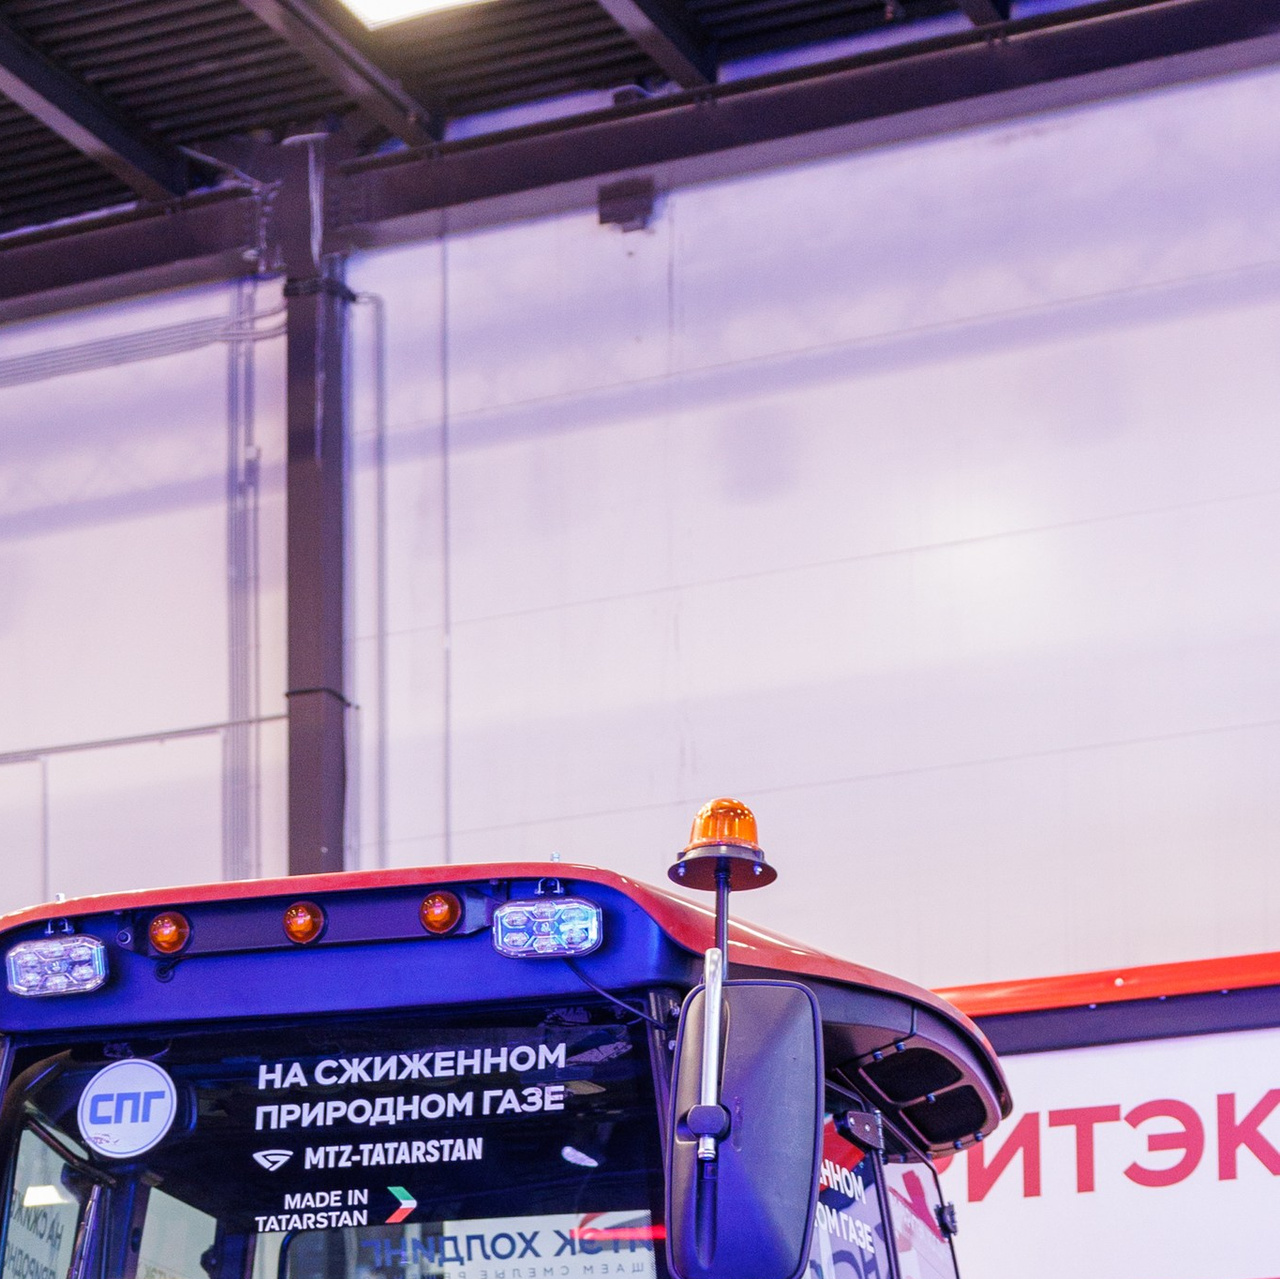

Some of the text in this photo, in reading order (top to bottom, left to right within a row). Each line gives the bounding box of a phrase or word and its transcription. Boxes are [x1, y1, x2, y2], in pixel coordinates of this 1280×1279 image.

[258, 1043, 568, 1090] НА СЖИЖЕННОМ
[89, 1090, 165, 1124] СПГ
[255, 1085, 565, 1131] ПРИРОДНОМ ГАЗЕ
[304, 1137, 483, 1170] MTZ-TATARSTAN
[935, 1087, 1280, 1203] ИТЭК
[284, 1188, 369, 1210] MADE IN
[819, 1158, 866, 1205] ННОМ
[255, 1208, 369, 1233] TATARSTAN
[839, 1211, 875, 1253] ГАЗЕ
